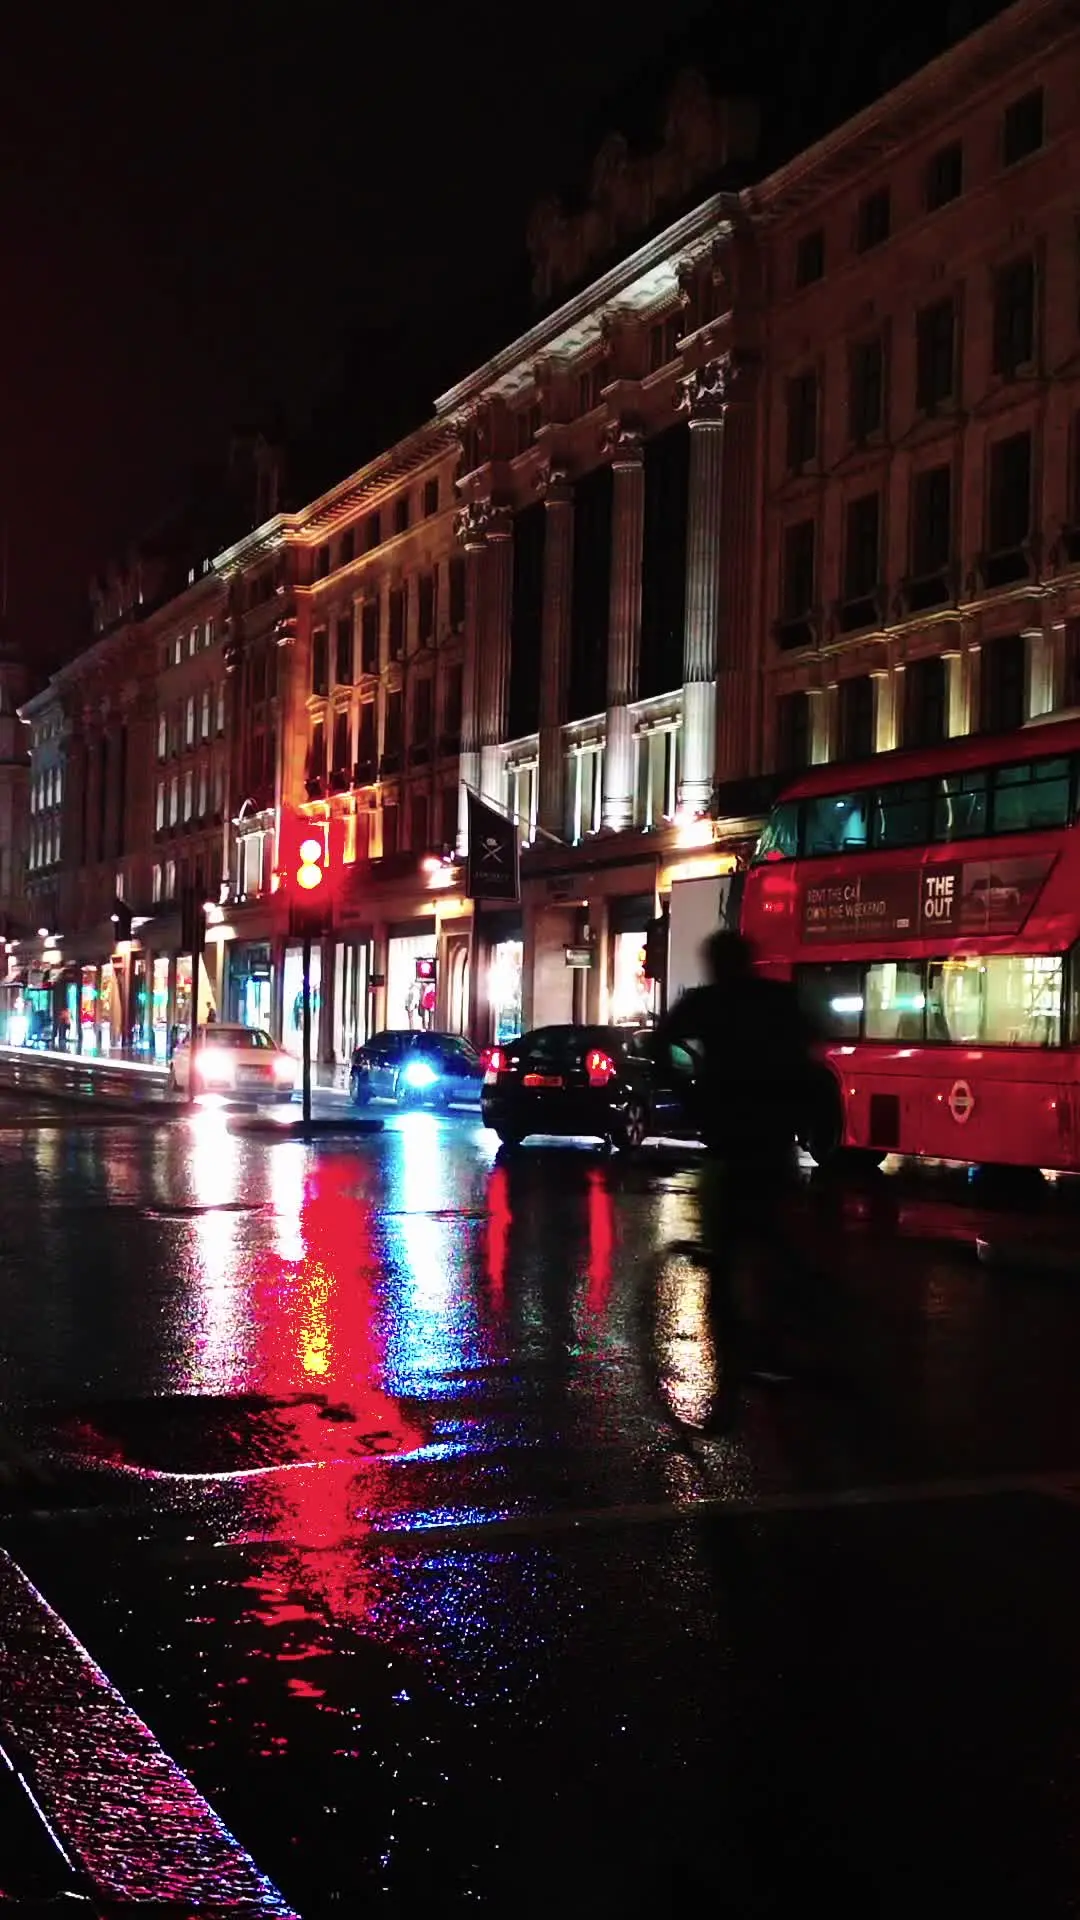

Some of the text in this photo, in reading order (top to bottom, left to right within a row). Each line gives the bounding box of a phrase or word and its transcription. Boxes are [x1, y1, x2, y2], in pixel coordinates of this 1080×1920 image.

[844, 885, 861, 900] CA
[926, 876, 955, 896] THE
[924, 897, 953, 918] OUT
